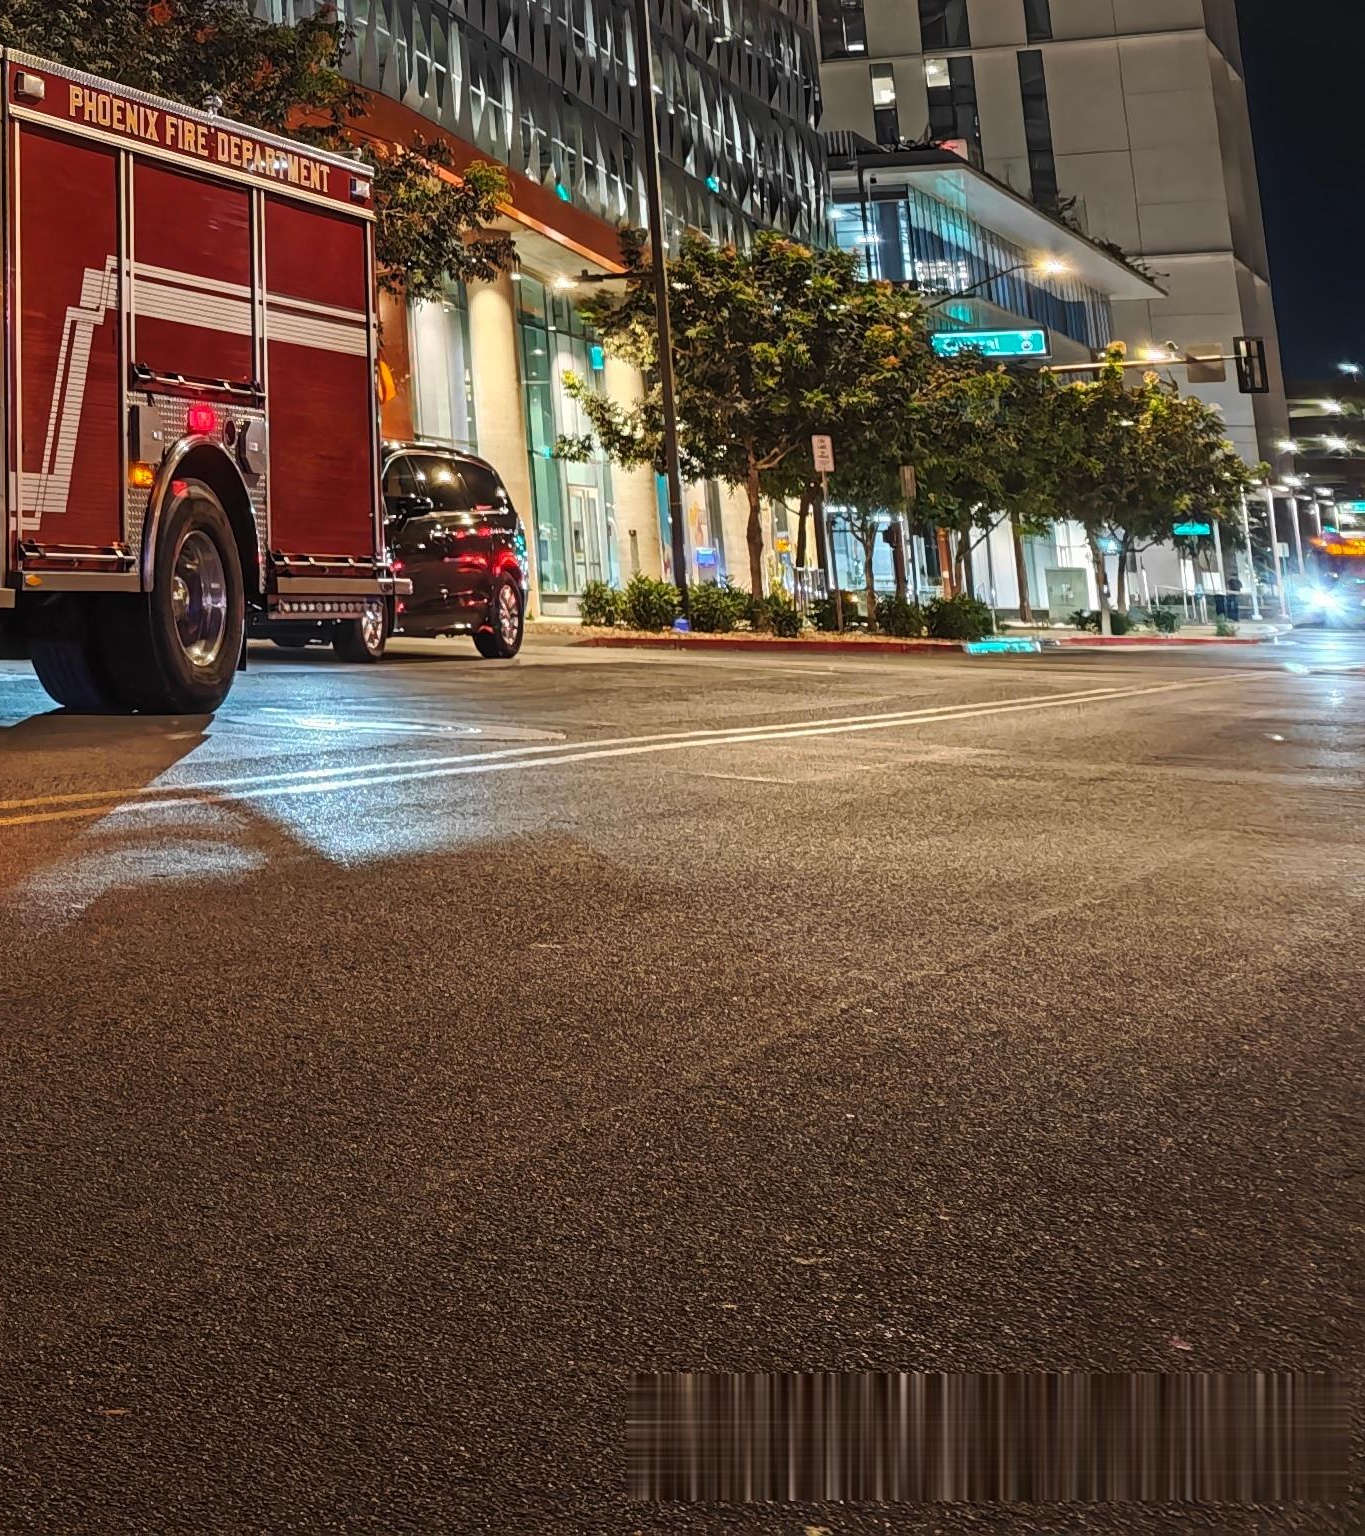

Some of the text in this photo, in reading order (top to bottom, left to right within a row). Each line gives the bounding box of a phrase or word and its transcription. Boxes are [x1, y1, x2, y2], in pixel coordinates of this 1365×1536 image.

[69, 84, 330, 192] PHOENIX FIRE DEPARTMENT
